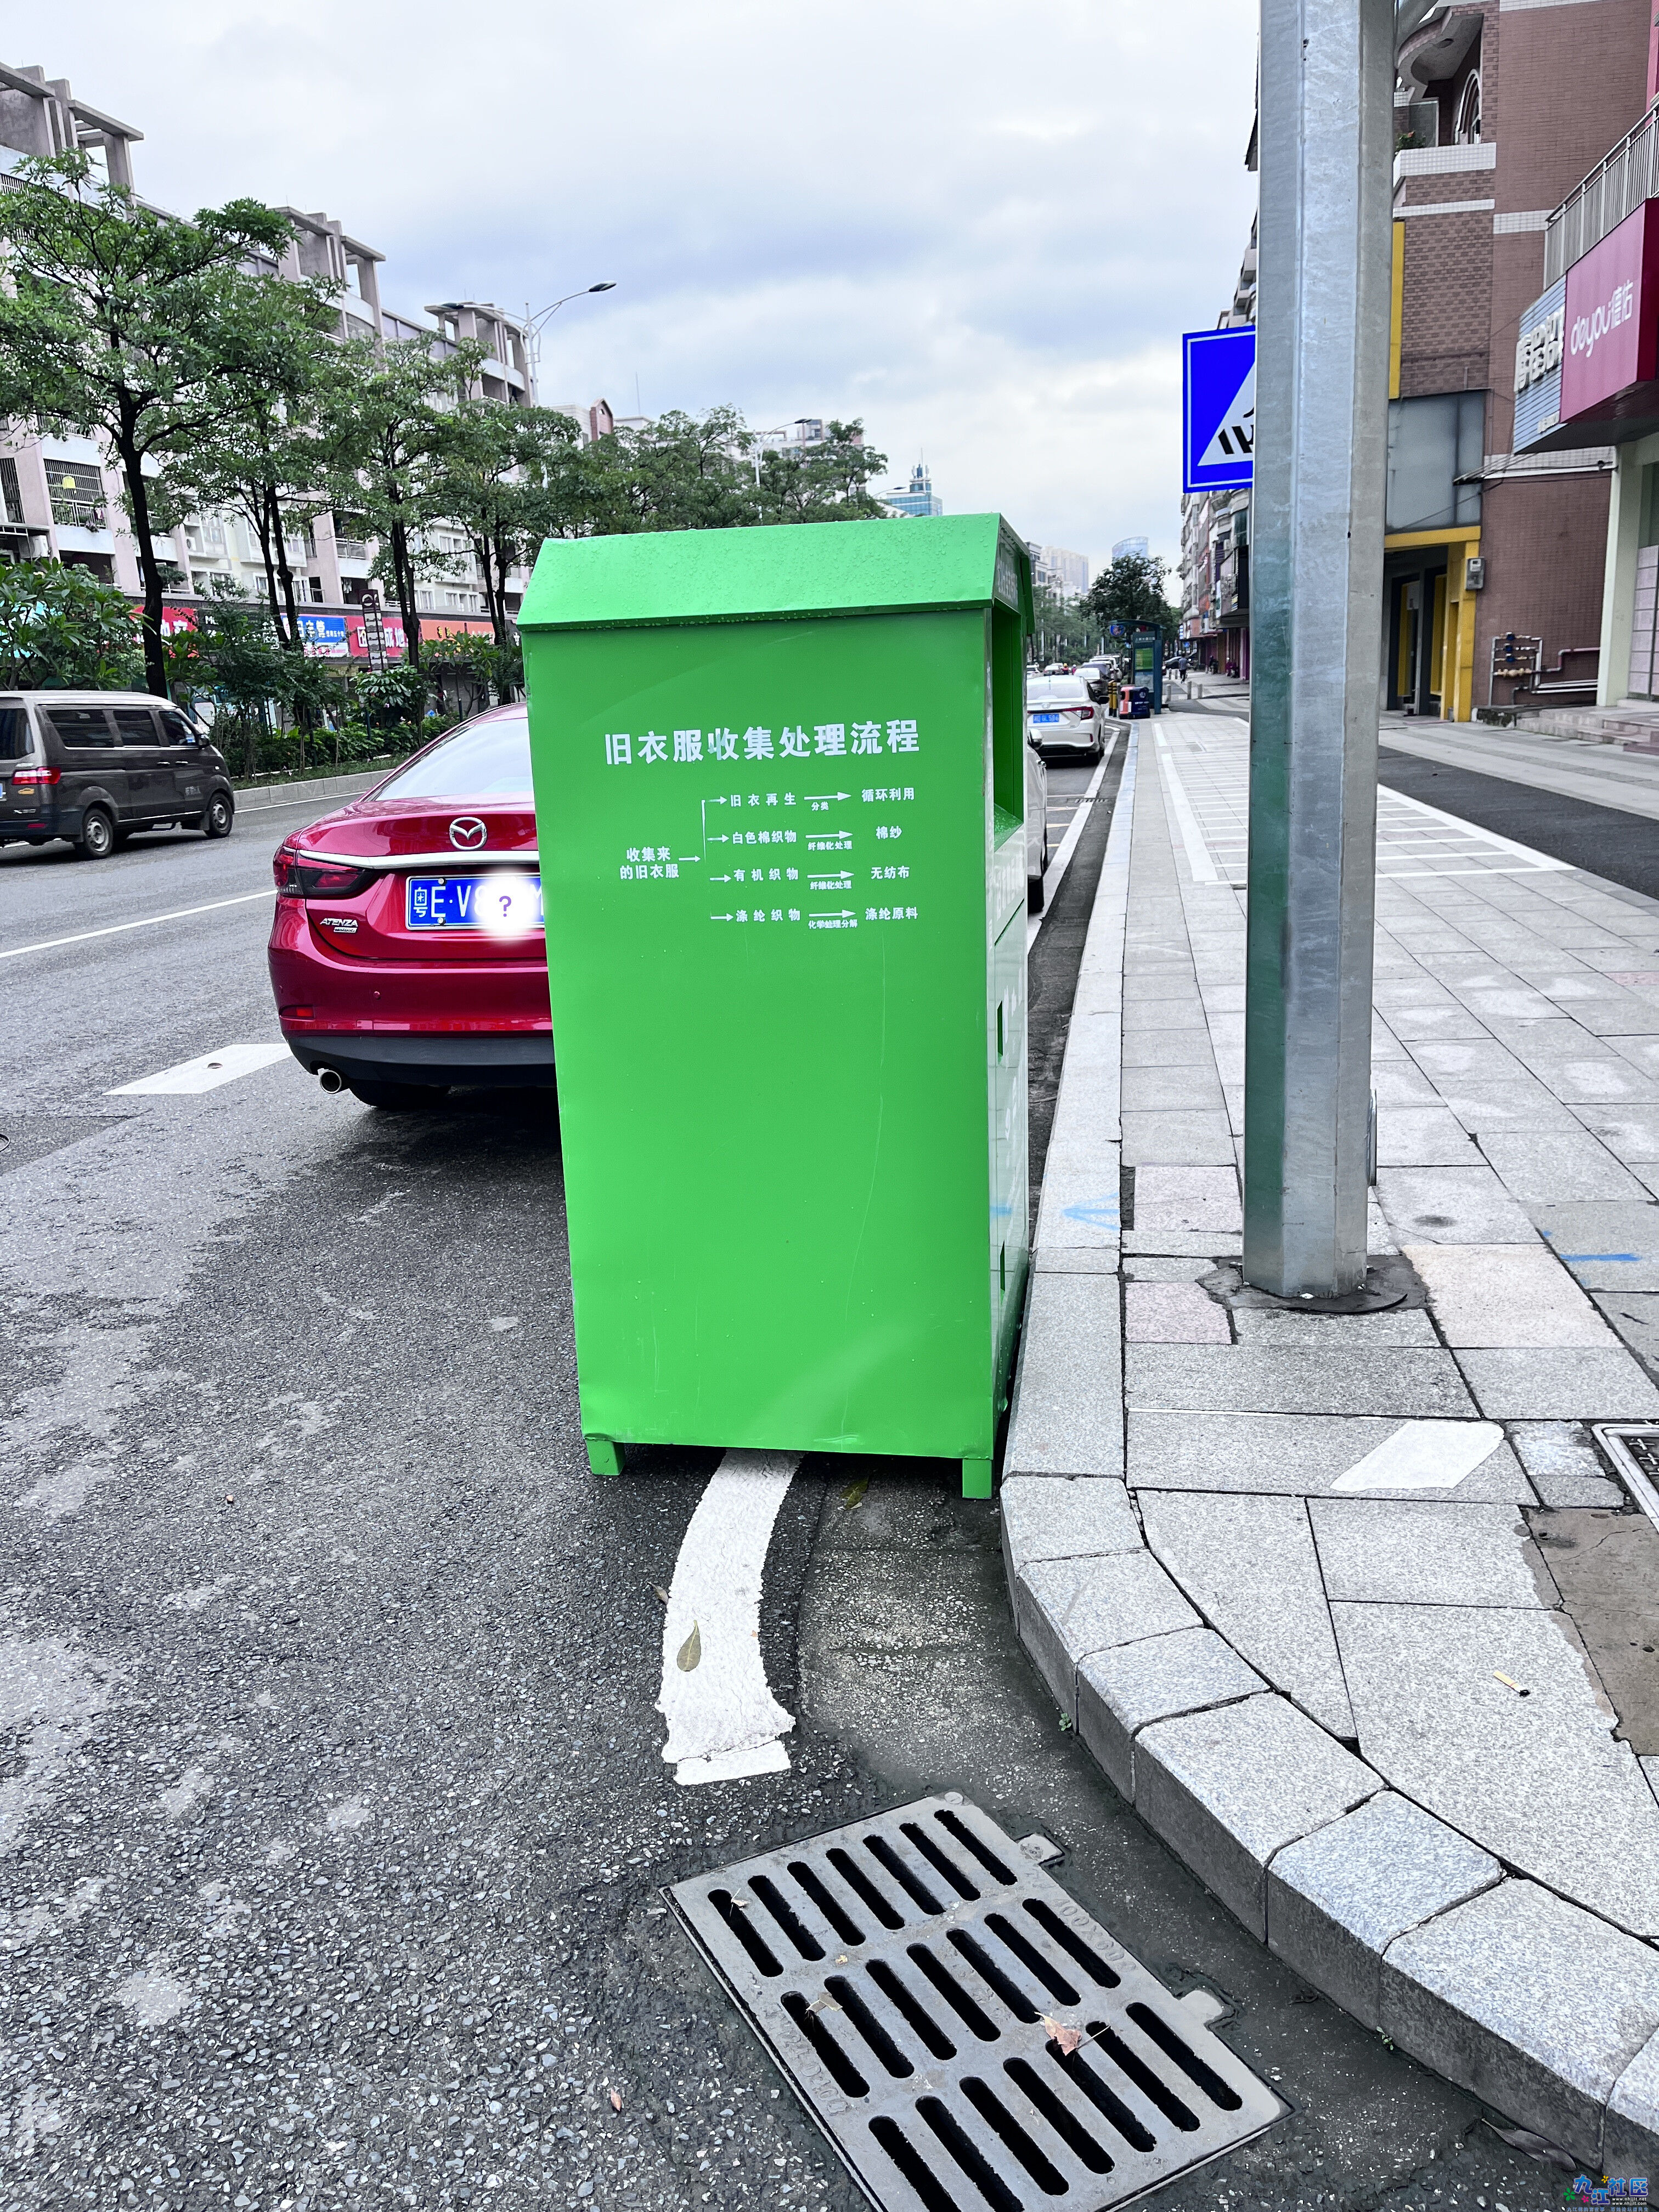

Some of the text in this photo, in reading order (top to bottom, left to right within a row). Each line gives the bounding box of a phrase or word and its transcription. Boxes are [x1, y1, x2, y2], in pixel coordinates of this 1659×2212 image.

[605, 720, 919, 764] 旧衣服收集处理流程
[731, 792, 796, 806] 旧衣再生
[862, 788, 914, 802] 循环利用
[811, 802, 828, 811] 分类
[733, 830, 796, 844] 白色棉织物
[876, 826, 902, 839] 棉纱
[808, 840, 852, 851] 纤维化处理
[627, 846, 670, 862] 收集来
[620, 861, 679, 879] 的旧衣服
[733, 867, 798, 881] 有机织物
[871, 866, 910, 879] 无纺布
[810, 881, 851, 890] 纤维化处理
[736, 909, 800, 922] 涤纶织物
[865, 907, 918, 920] 涤纶原料
[320, 918, 358, 927] ATENZA
[809, 919, 857, 929] 化学处理分解
